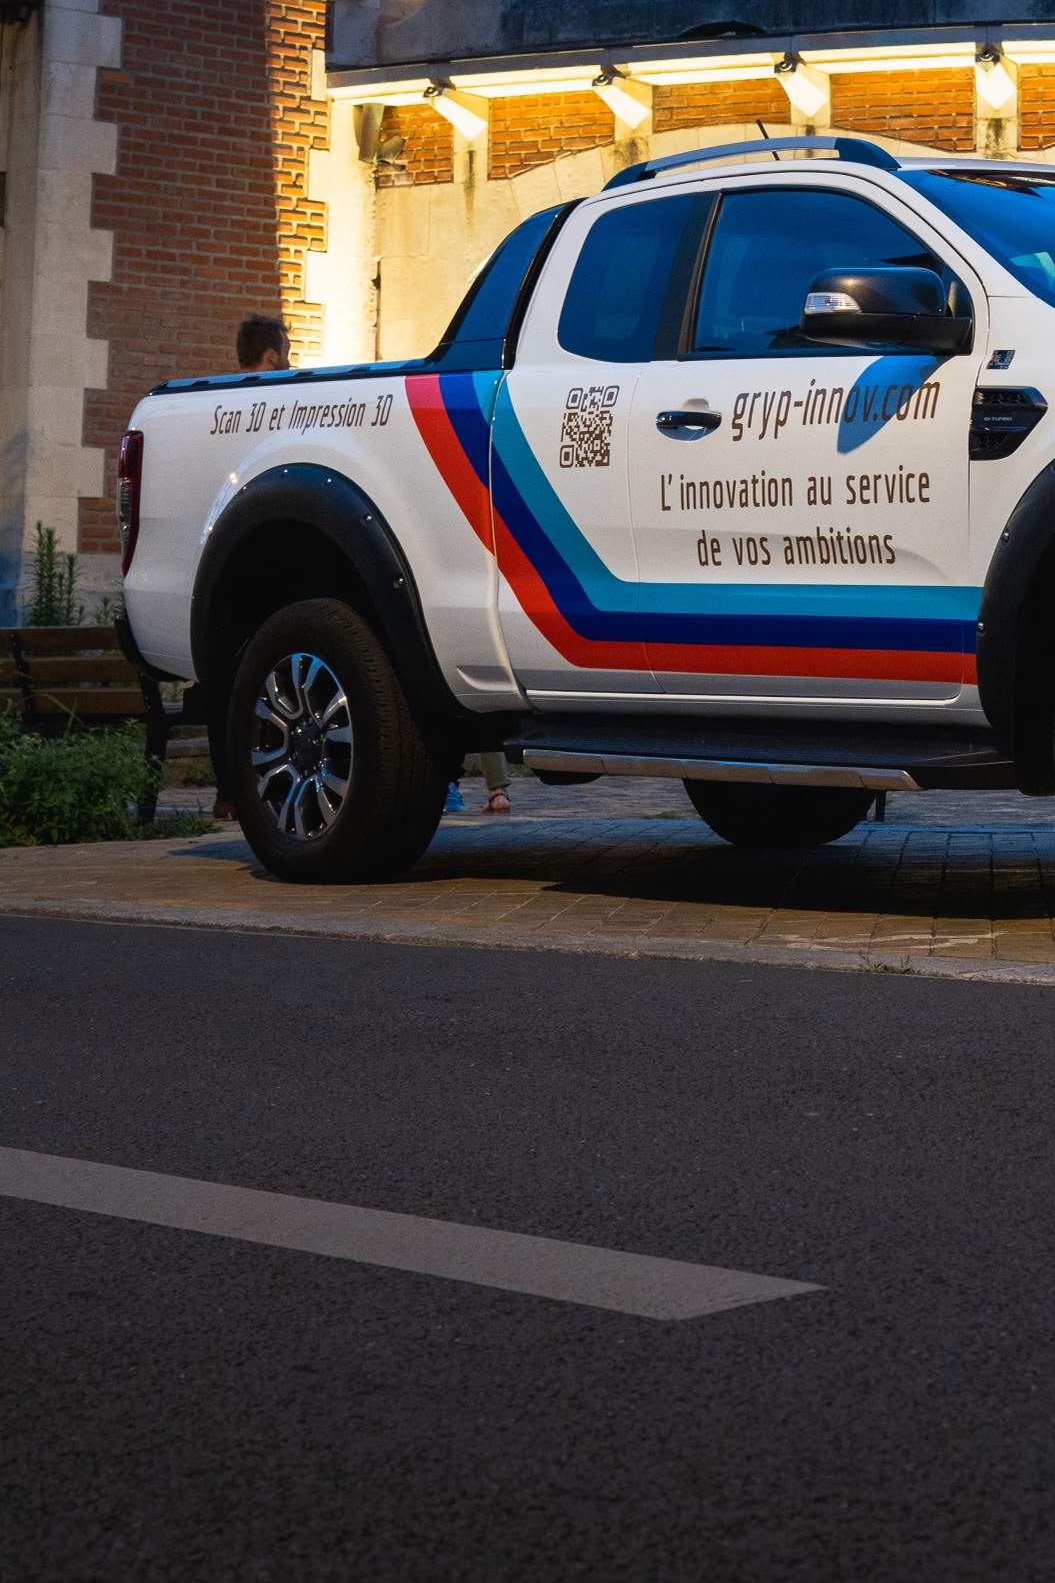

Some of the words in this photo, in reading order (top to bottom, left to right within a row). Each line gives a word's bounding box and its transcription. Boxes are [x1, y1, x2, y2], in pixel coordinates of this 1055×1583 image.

[210, 404, 241, 435] Scan
[246, 401, 266, 433] 3D
[269, 404, 286, 431] et
[288, 397, 366, 435] Impression
[371, 393, 394, 427] 3D
[731, 378, 940, 441] gryp-innov.com
[807, 474, 832, 506] au
[846, 464, 930, 504] service
[697, 529, 721, 566] de
[732, 533, 771, 566] vos
[783, 526, 896, 565] ambitions
